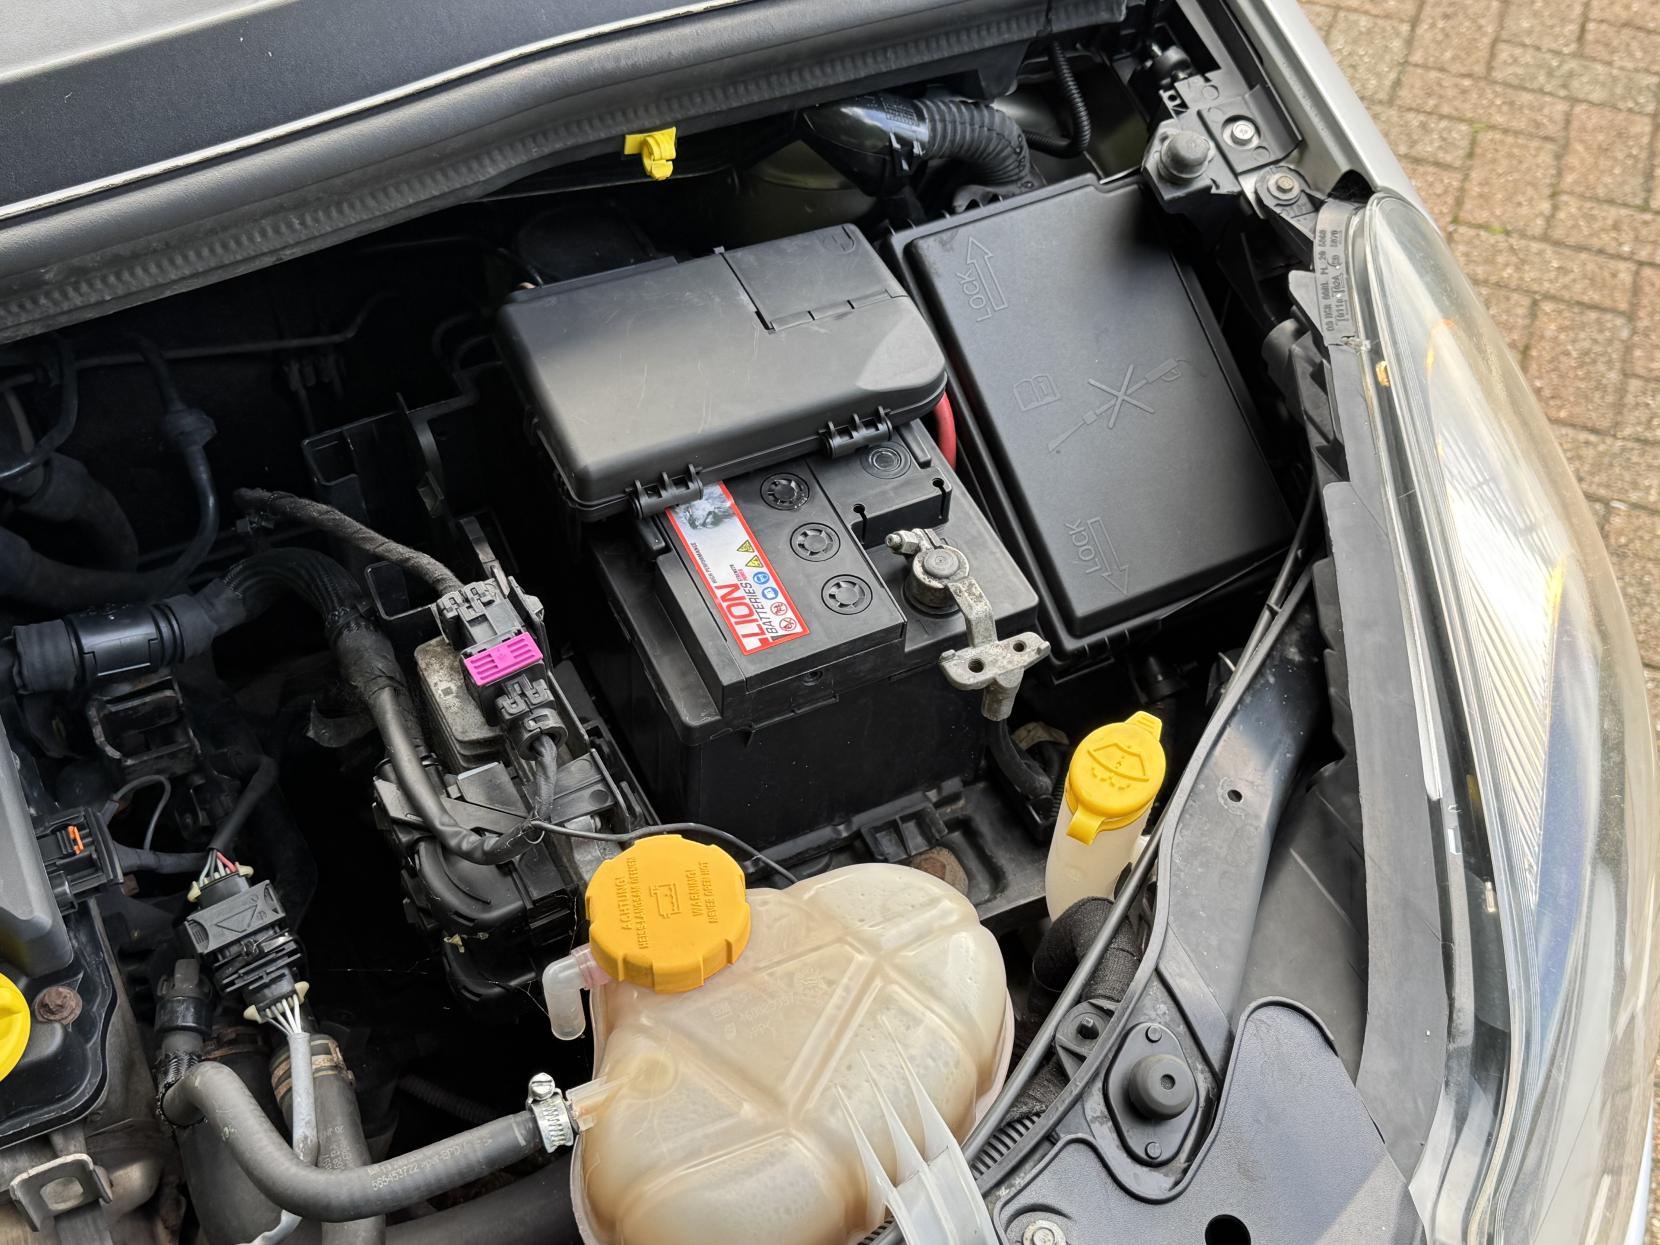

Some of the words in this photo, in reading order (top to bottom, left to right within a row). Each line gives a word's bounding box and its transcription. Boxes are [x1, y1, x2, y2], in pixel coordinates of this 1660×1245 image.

[955, 269, 992, 323] LOCK
[690, 542, 712, 575] PERFORMANCE
[1064, 518, 1103, 575] LOCK
[714, 582, 766, 639] LION
[740, 582, 779, 635] BATTERIES
